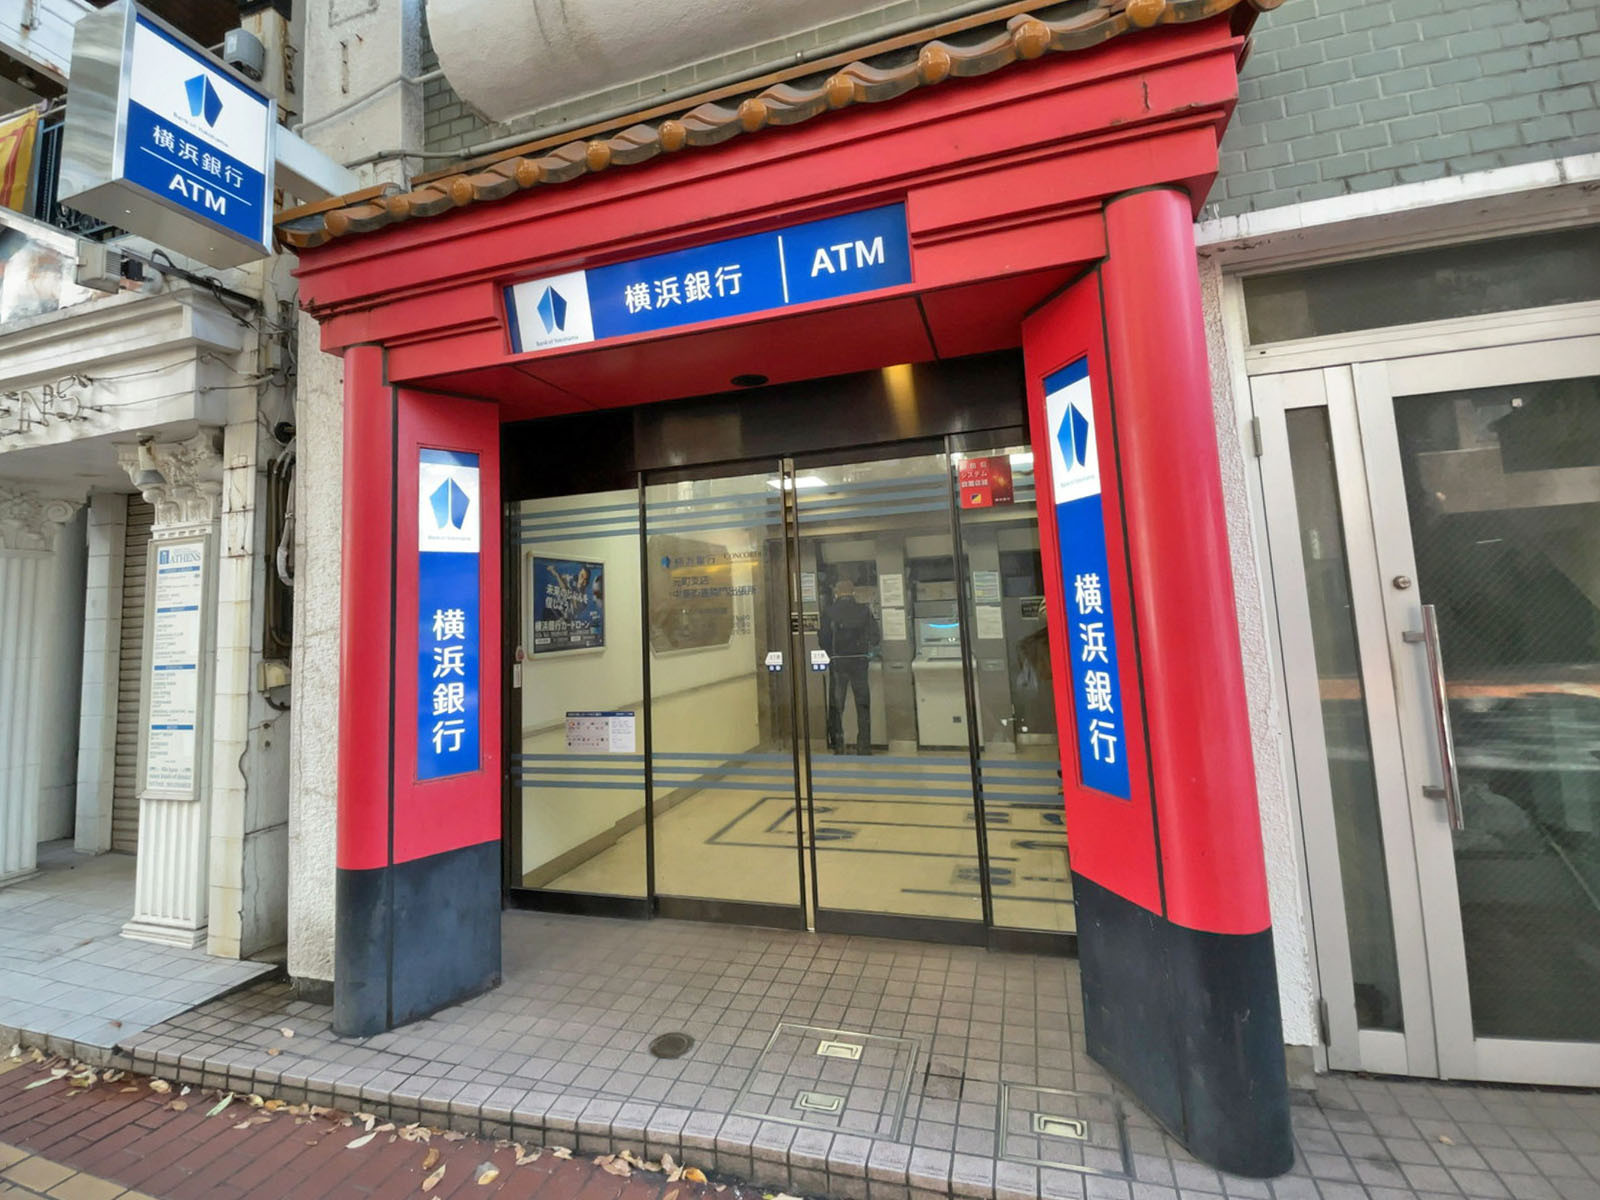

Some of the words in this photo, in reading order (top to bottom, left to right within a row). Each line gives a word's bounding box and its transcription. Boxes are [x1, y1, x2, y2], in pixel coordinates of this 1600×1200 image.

[152, 124, 244, 188] 横浜銀行
[168, 173, 227, 217] ATM
[810, 236, 886, 278] ATM
[624, 263, 743, 315] 横浜銀行
[432, 608, 466, 755] 横浜銀行
[1074, 572, 1119, 766] 横浜銀行
